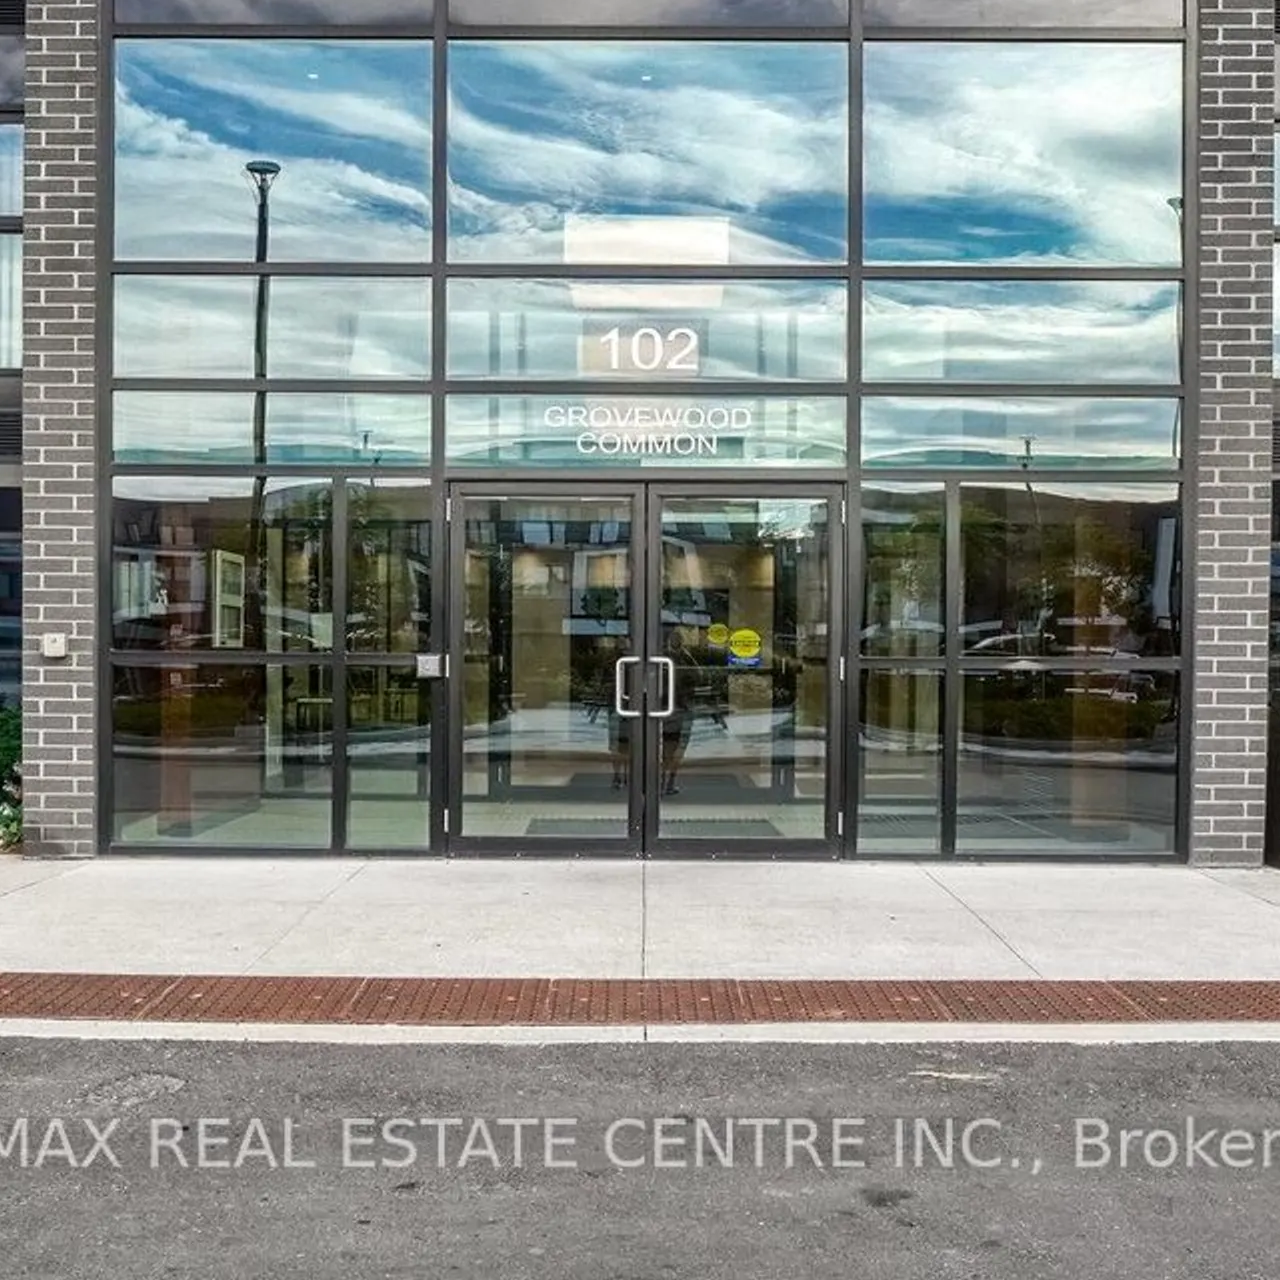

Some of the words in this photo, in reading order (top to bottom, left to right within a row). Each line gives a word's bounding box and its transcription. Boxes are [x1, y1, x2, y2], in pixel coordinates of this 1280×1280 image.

[600, 327, 698, 370] 102
[544, 406, 752, 429] GROVEWOOD
[577, 432, 718, 454] COMMON
